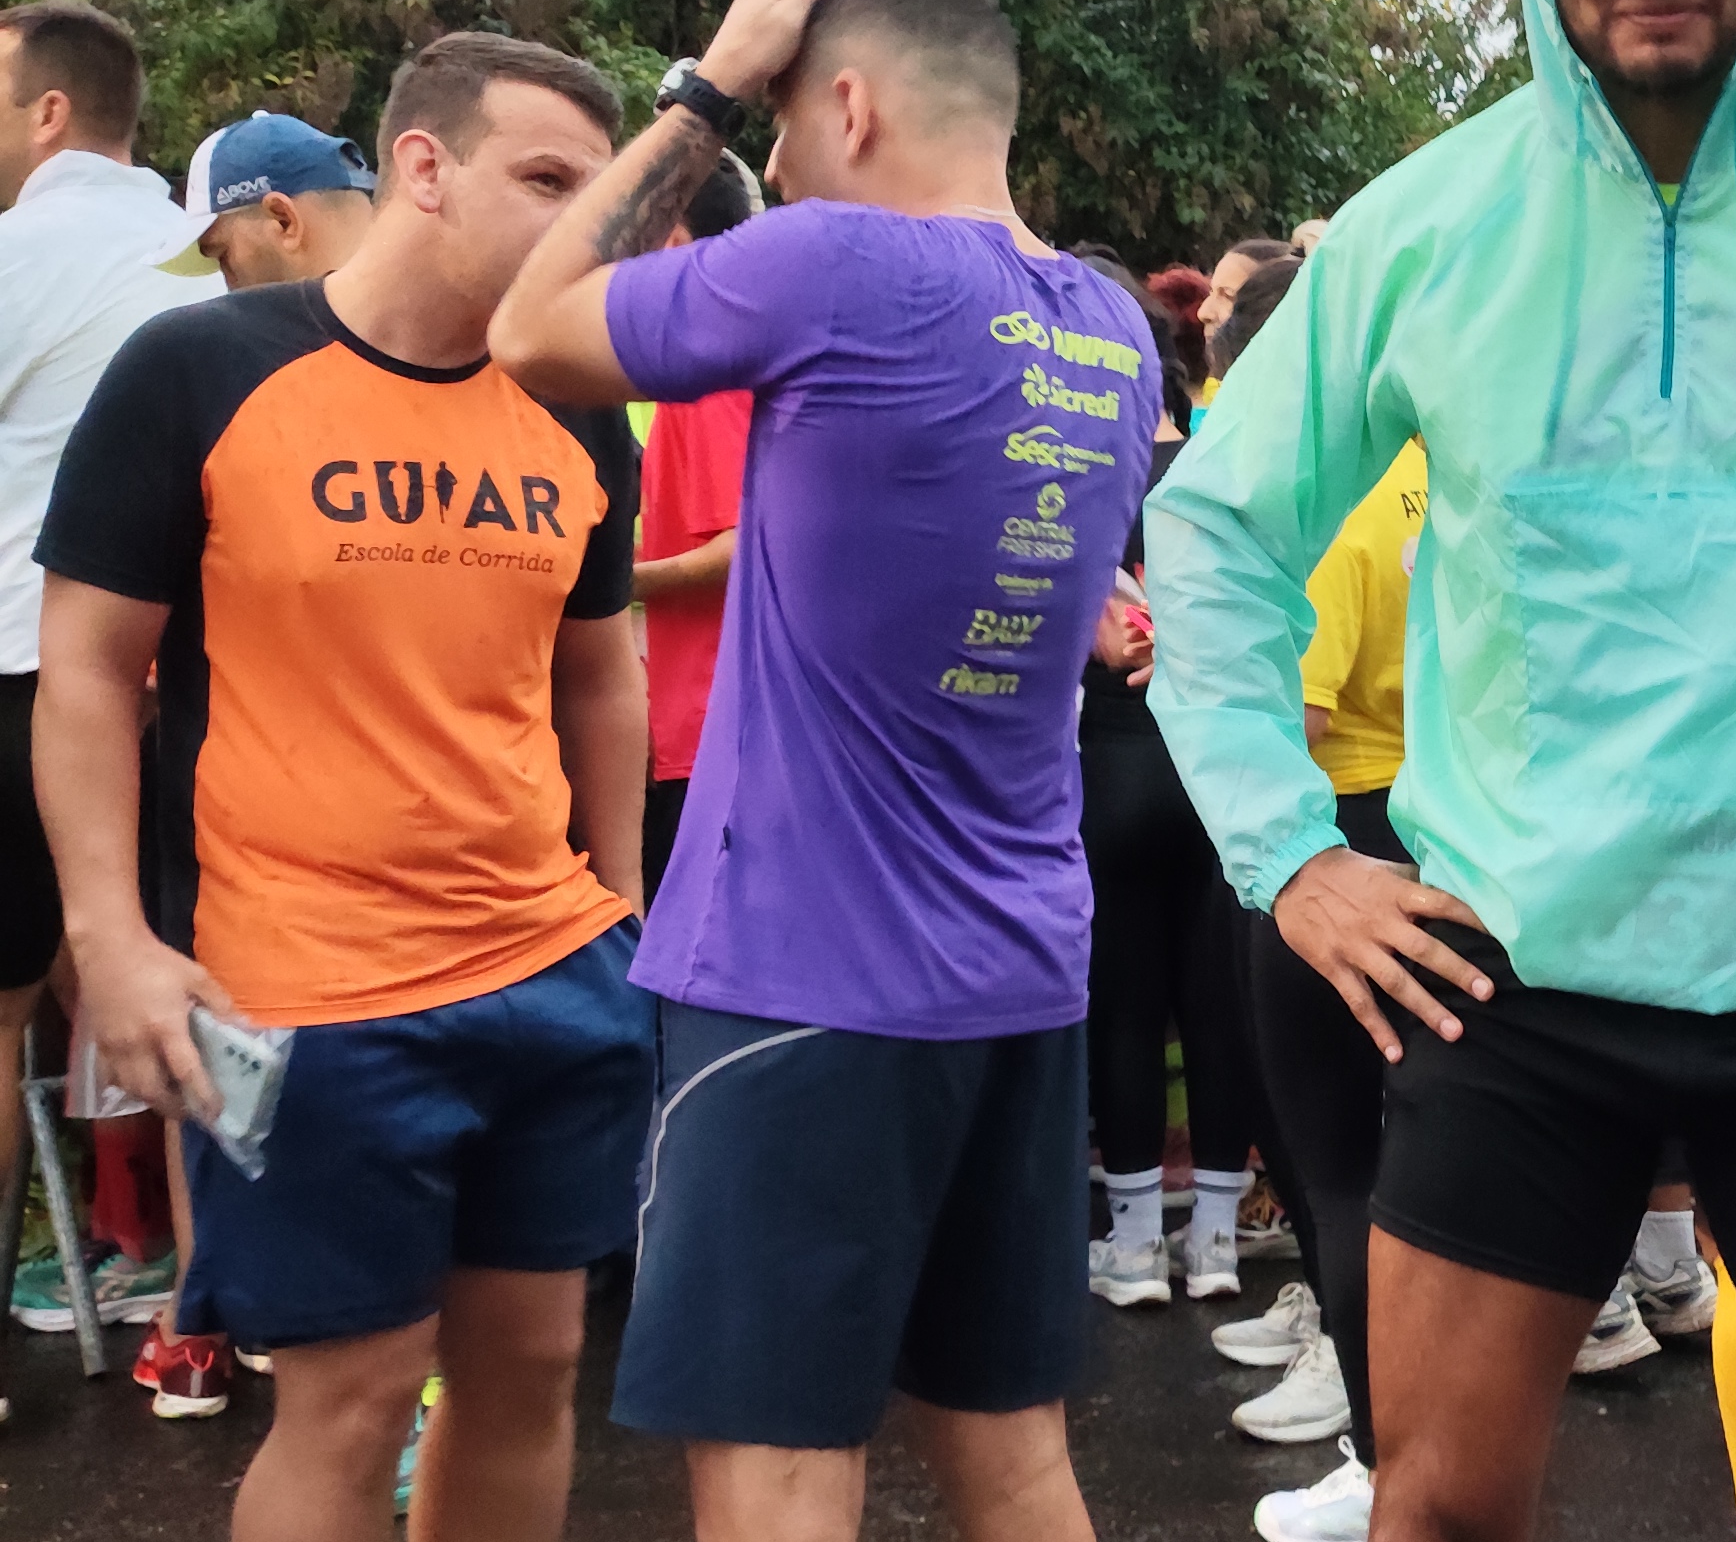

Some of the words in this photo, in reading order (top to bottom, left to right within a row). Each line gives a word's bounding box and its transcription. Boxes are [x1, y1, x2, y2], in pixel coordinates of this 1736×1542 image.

[335, 542, 414, 563] Escola
[421, 545, 450, 565] de
[459, 547, 554, 574] Corrida
